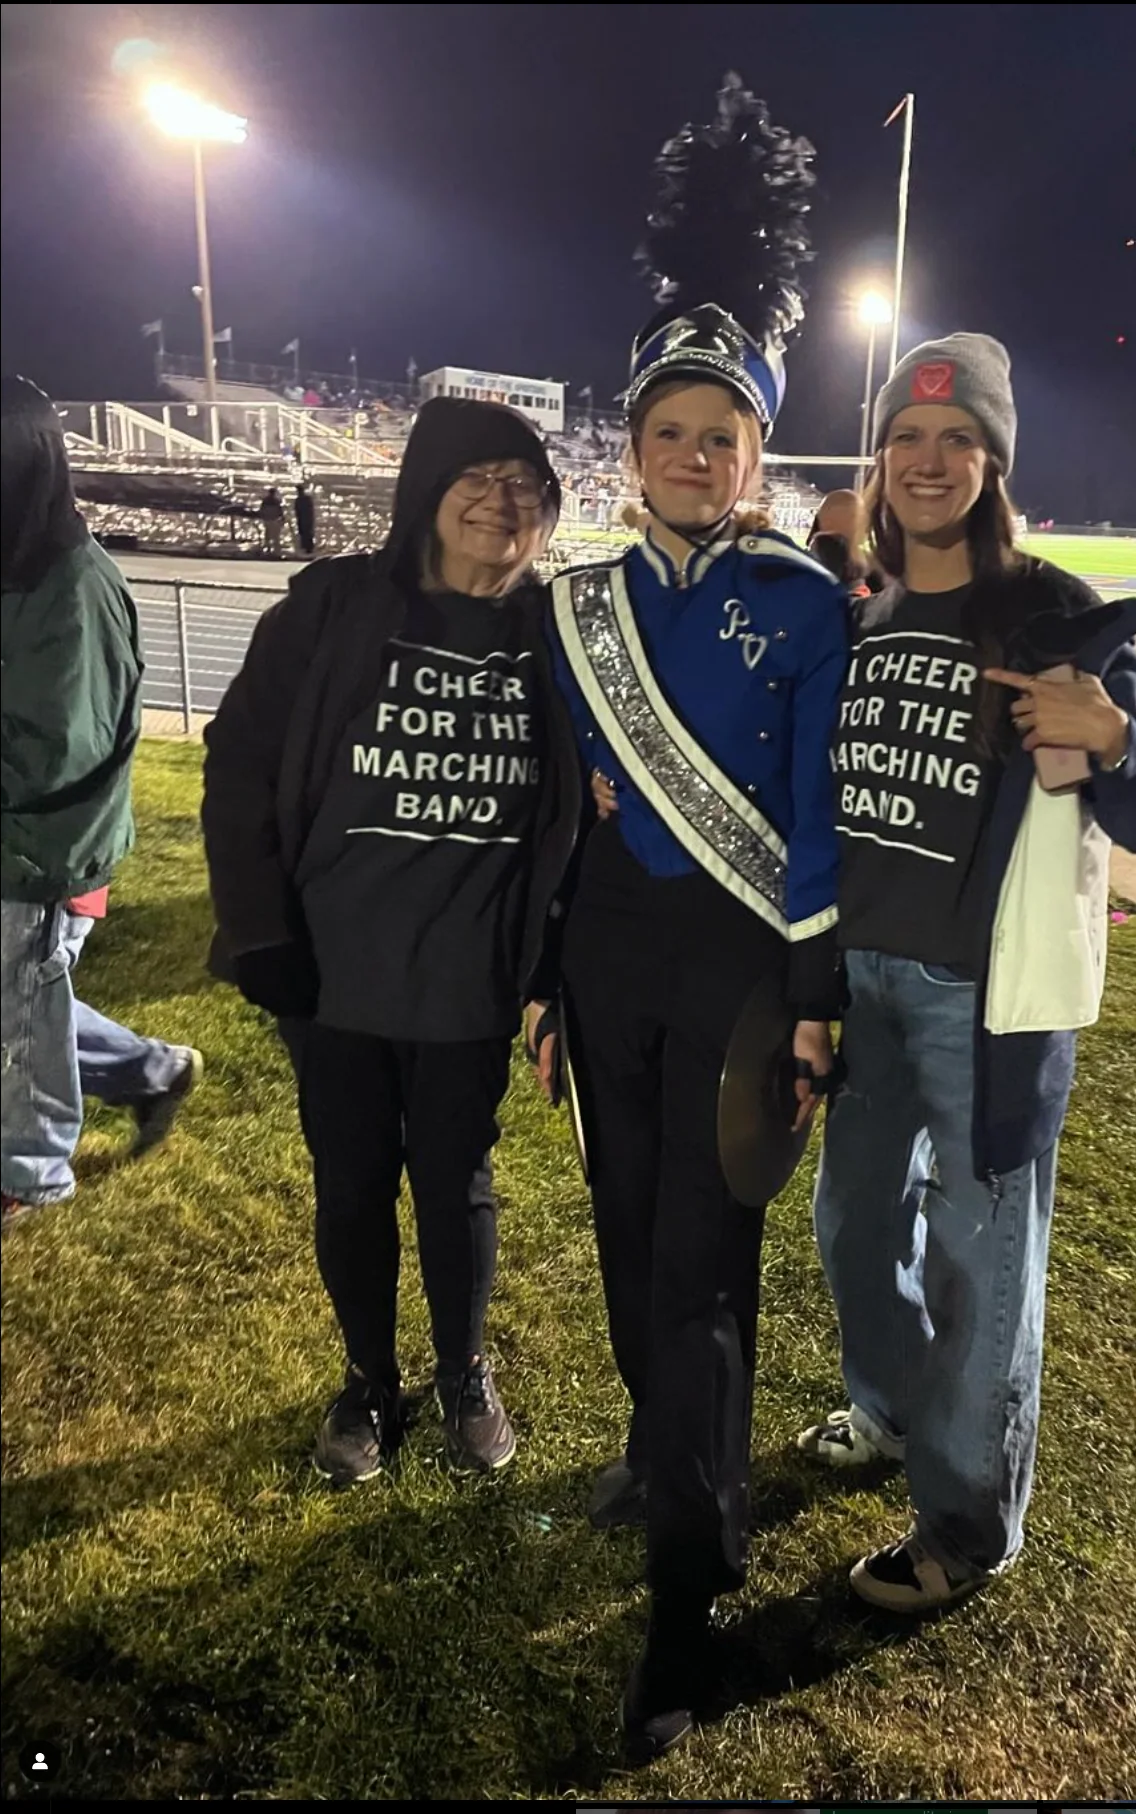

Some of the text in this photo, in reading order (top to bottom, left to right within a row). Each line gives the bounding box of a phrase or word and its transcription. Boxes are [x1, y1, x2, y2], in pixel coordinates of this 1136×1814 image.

[388, 660, 526, 701] I CHEER
[847, 652, 978, 695] I CHEER
[376, 702, 532, 742] FOR THE
[899, 700, 973, 742] THE
[352, 744, 539, 785] MARCHING
[841, 784, 924, 830] BAND.
